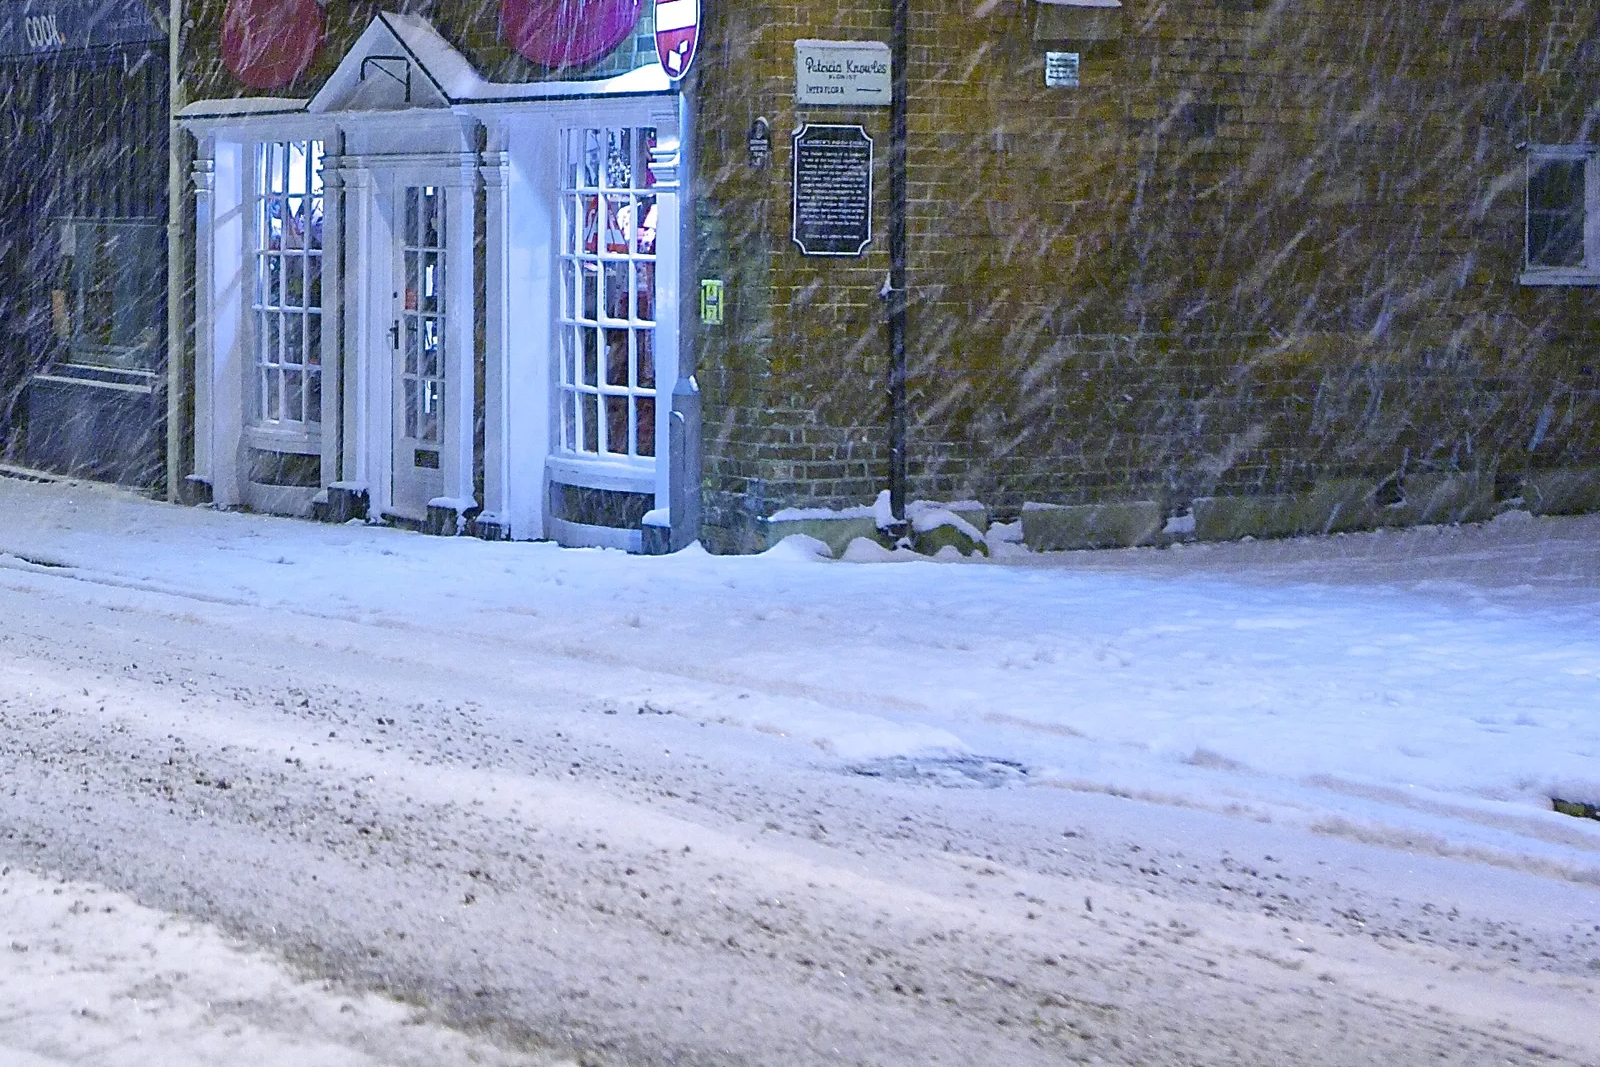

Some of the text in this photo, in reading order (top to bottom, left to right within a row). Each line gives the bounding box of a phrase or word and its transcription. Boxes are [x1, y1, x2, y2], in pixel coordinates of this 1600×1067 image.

[26, 14, 62, 47] COOK
[805, 56, 887, 74] Patricia Knowles
